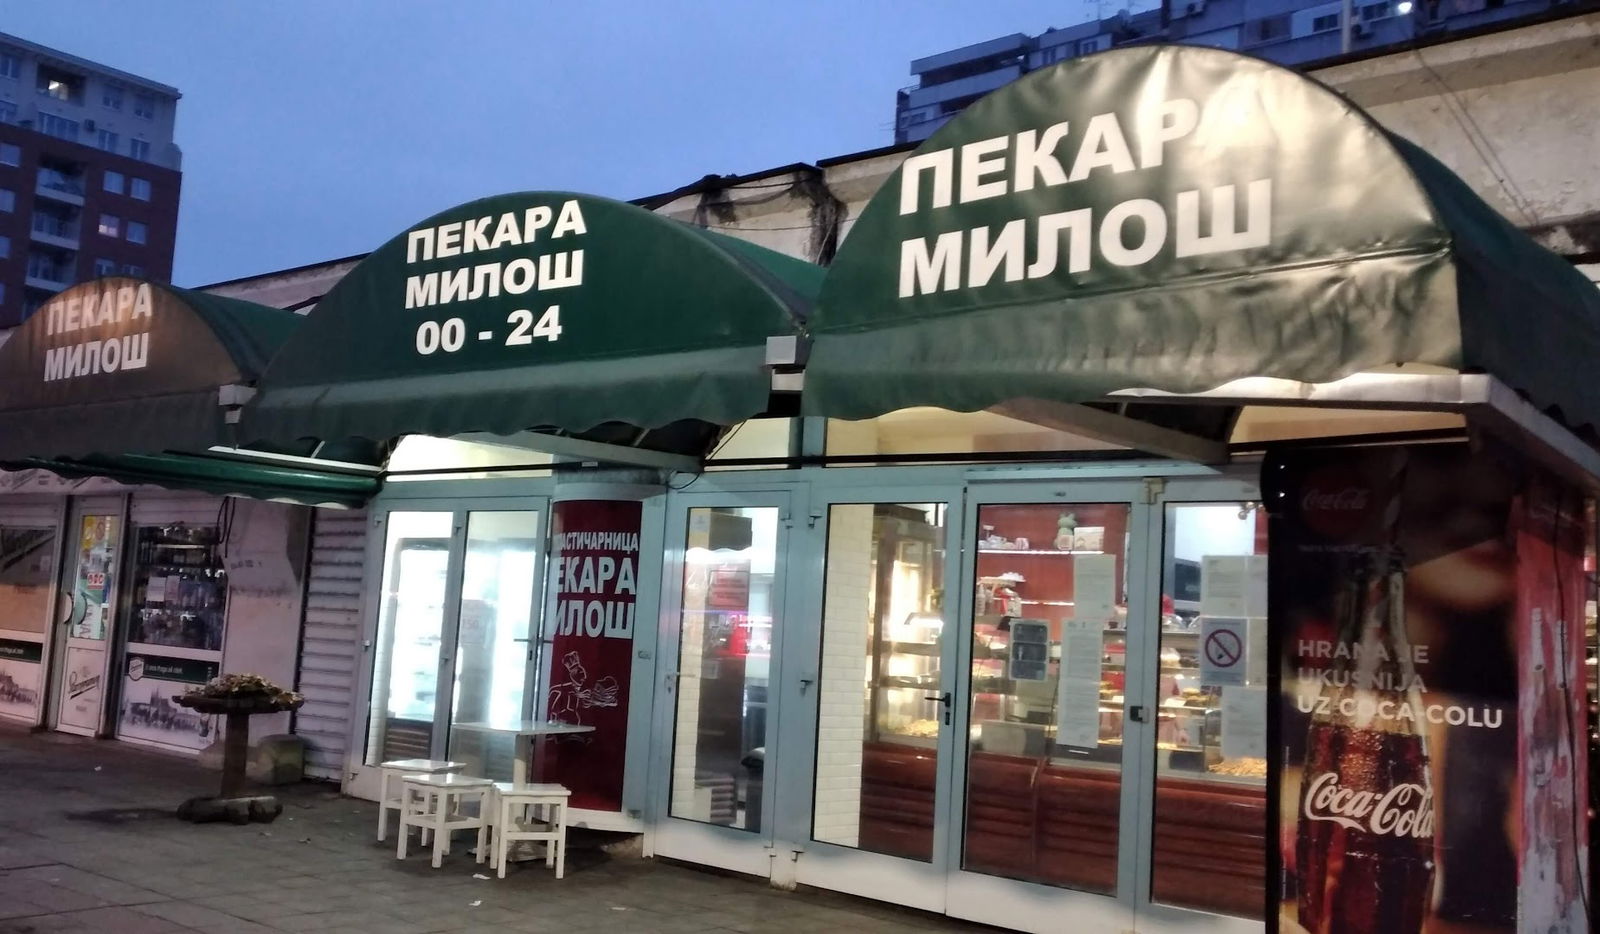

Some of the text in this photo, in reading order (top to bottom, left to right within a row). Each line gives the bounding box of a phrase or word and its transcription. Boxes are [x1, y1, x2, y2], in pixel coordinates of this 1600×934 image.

[407, 200, 587, 264] ПЕКАРА
[899, 178, 1272, 298] МИЛОШ
[405, 249, 585, 309] МИЛОШ
[47, 283, 153, 336] ПЕКАРА
[416, 305, 562, 355] 00 - 24
[44, 332, 149, 381] МИЛОШ
[1299, 639, 1390, 662] HRANA
[1299, 667, 1428, 693] UKUSNIJA
[1298, 695, 1503, 729] UZ COCA-COLU
